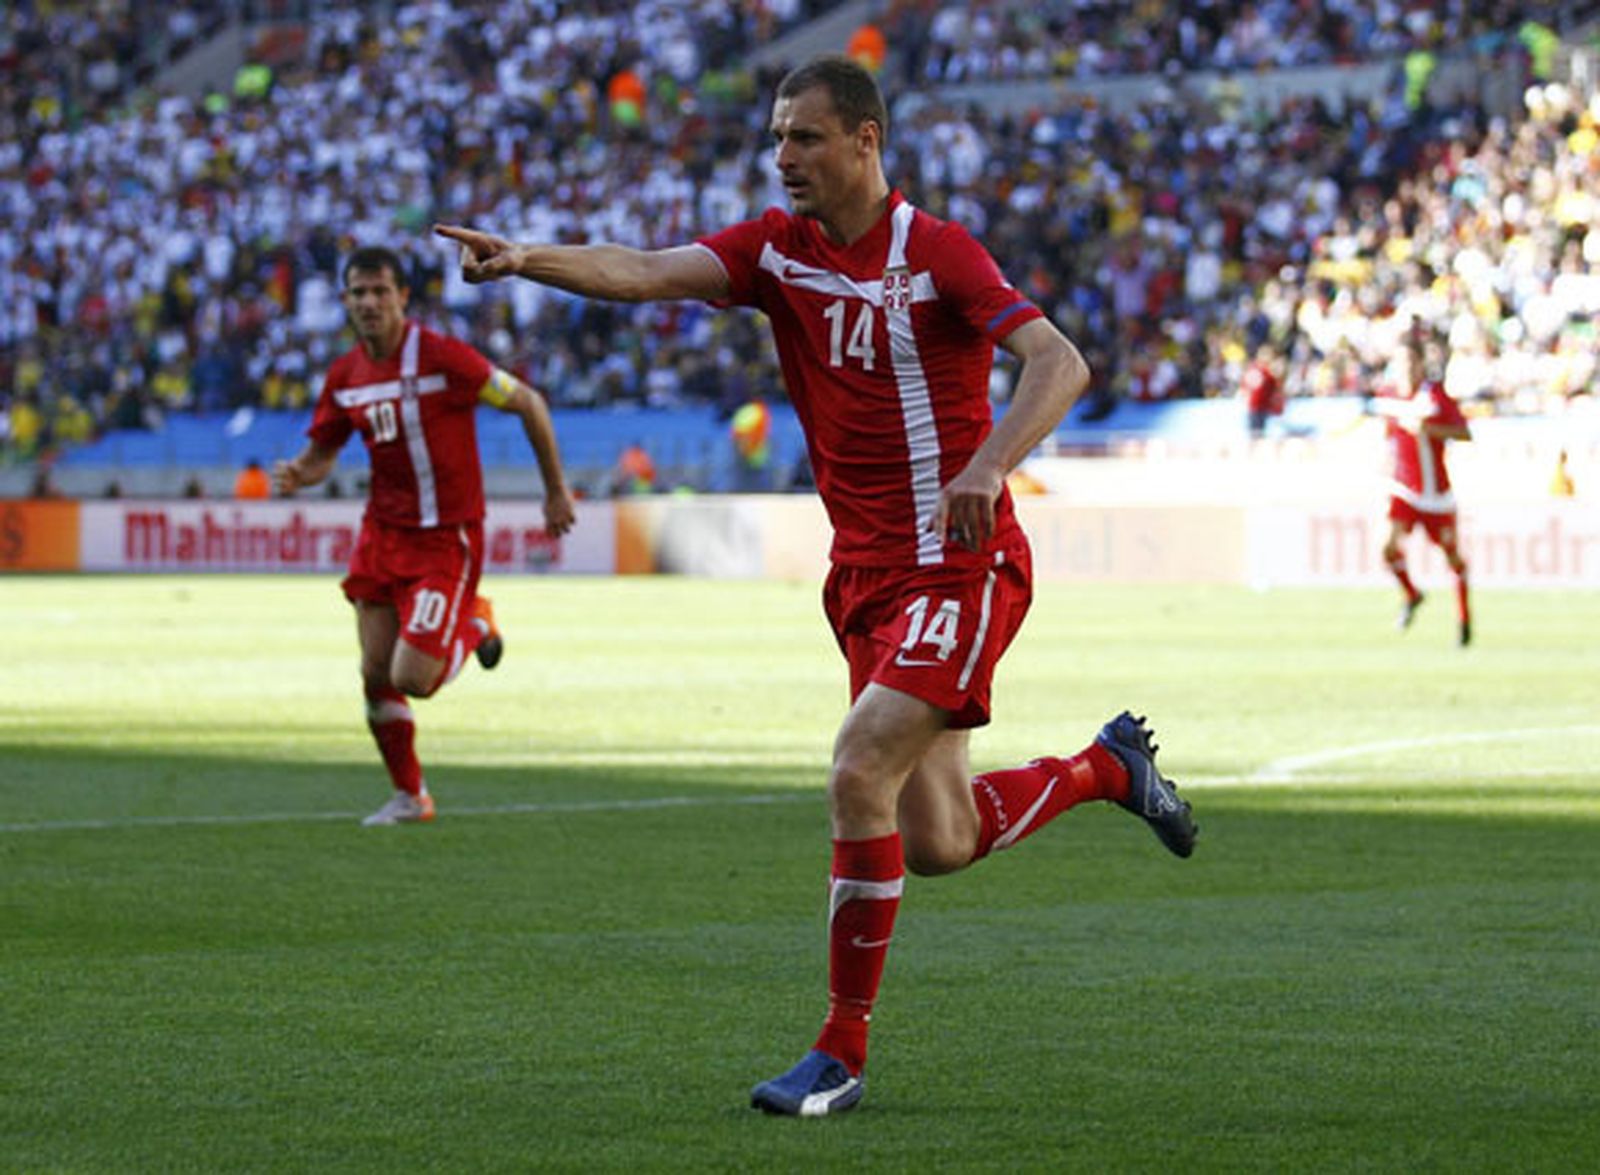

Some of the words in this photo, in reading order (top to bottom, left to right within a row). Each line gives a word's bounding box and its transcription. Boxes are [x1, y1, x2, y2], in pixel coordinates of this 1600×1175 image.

[822, 299, 875, 371] 14
[365, 401, 397, 443] 10
[125, 510, 355, 562] Mahindra
[407, 588, 448, 633] 10
[900, 596, 961, 661] 14
